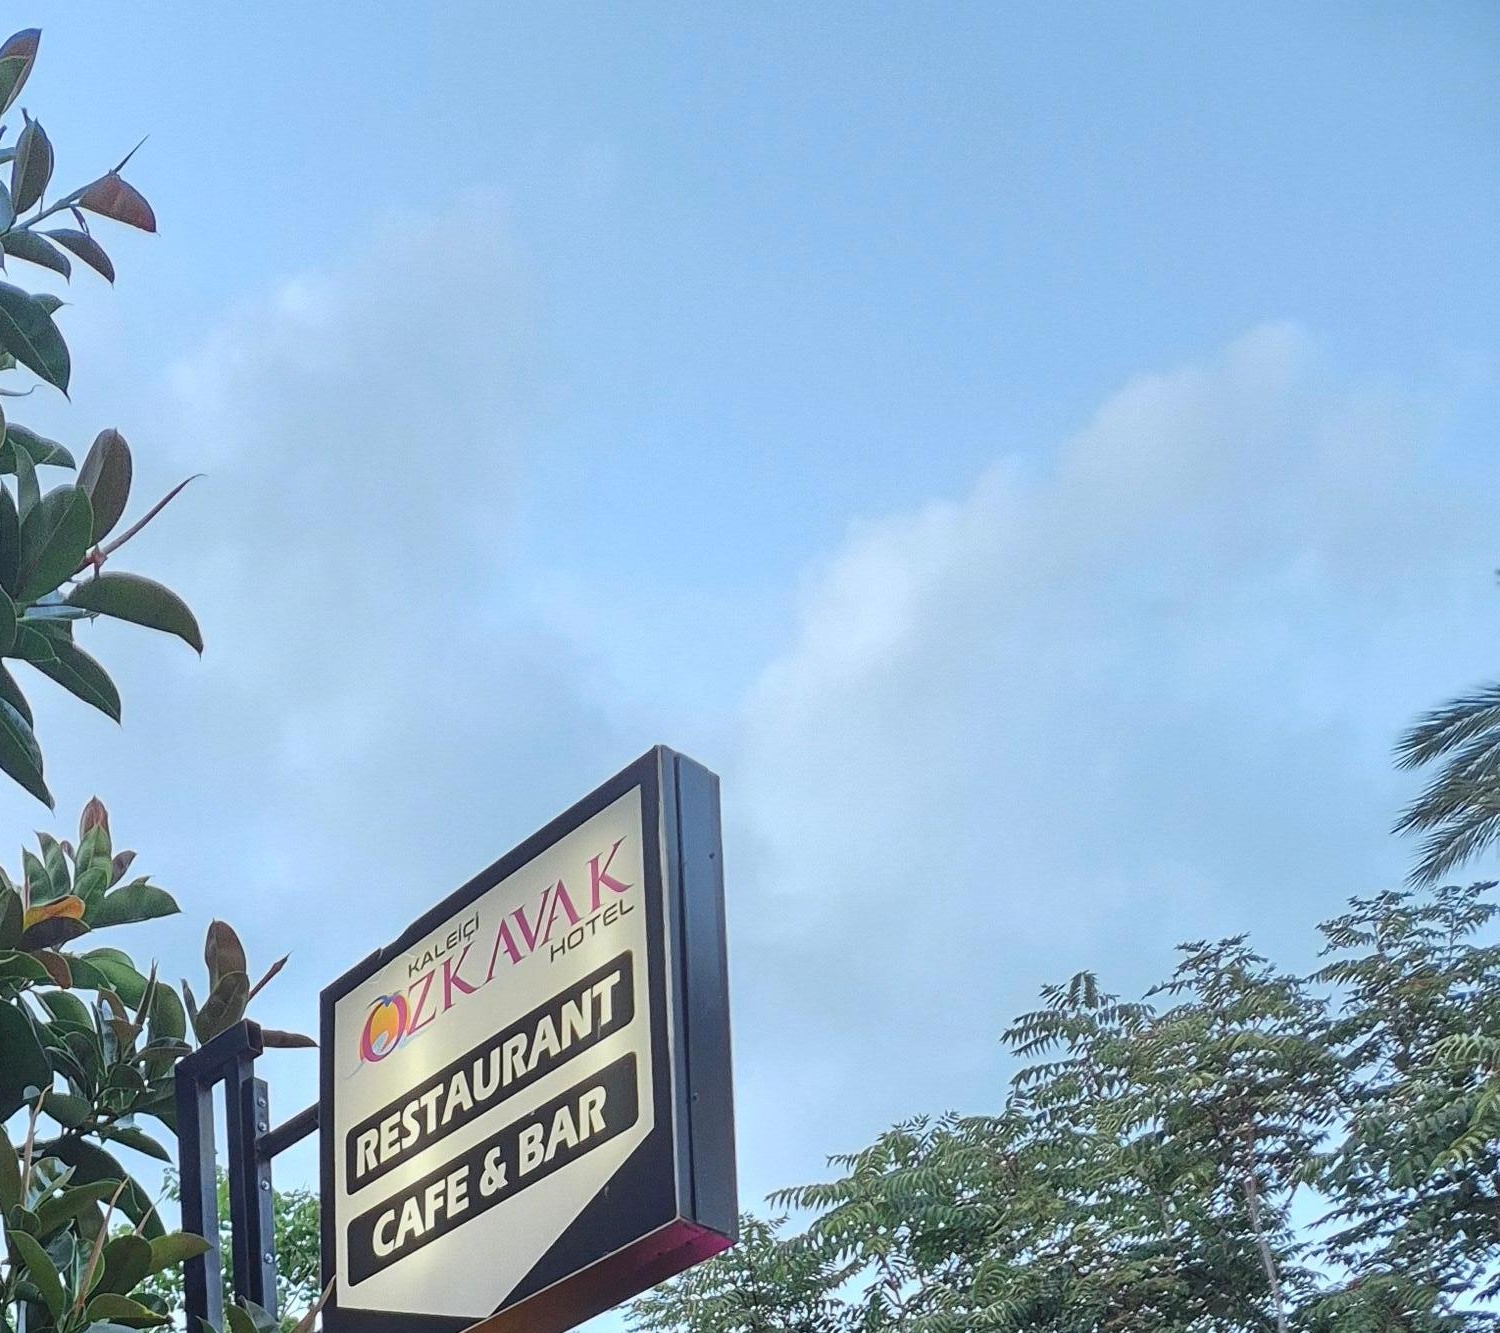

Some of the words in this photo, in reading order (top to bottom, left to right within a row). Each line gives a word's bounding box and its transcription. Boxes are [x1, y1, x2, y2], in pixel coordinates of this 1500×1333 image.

[550, 899, 635, 963] HOTEL
[356, 970, 621, 1179] RESTAURANT
[372, 1165, 470, 1257] CAFE
[479, 1146, 509, 1197] &
[518, 1085, 607, 1178] BAR
